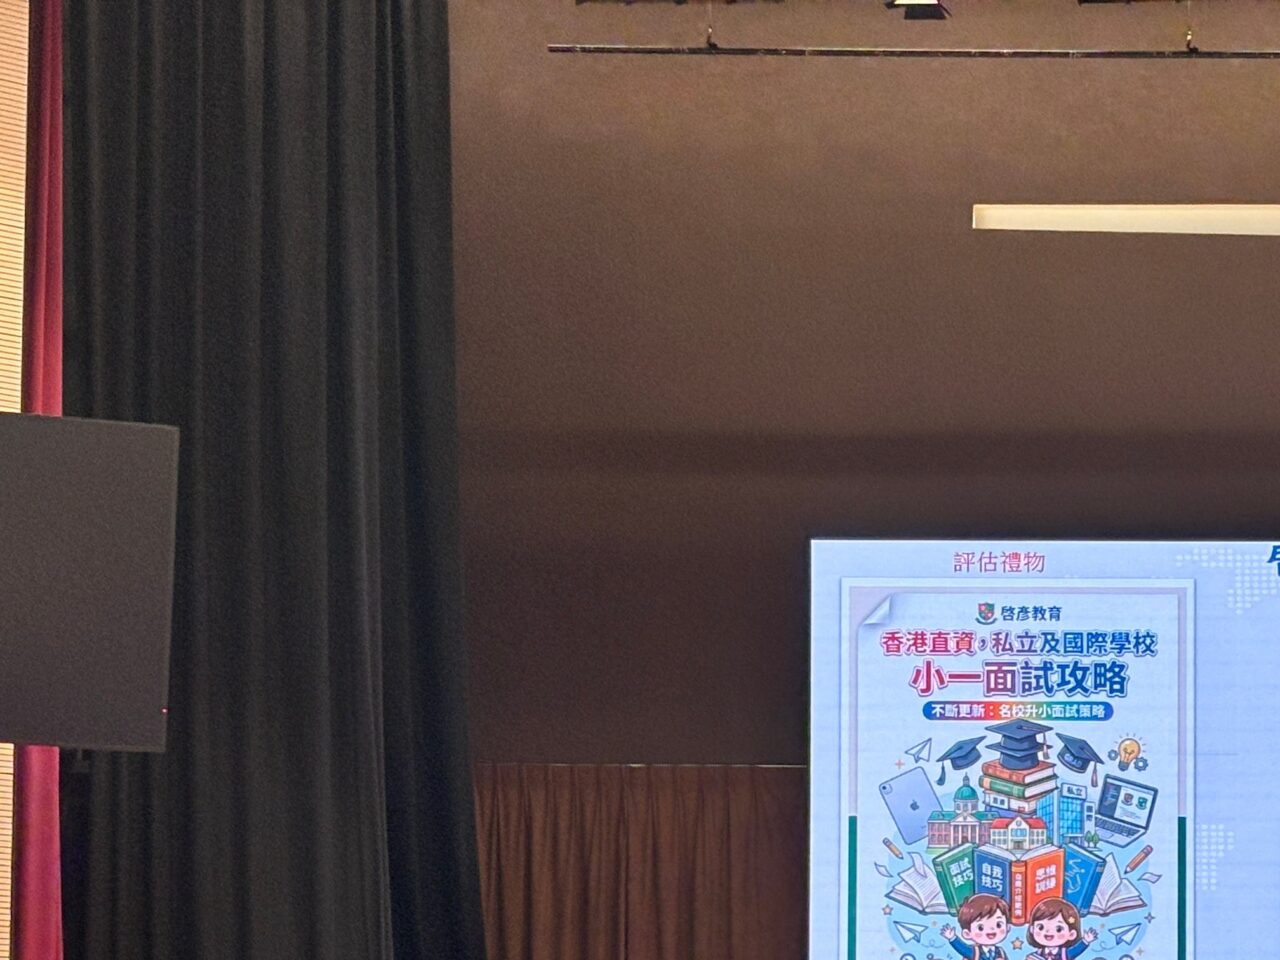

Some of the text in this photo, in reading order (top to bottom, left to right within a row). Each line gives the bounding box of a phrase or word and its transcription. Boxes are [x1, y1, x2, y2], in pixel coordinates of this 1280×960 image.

[953, 551, 1046, 574] 評估禮物
[911, 660, 1128, 696] 小一面試攻略
